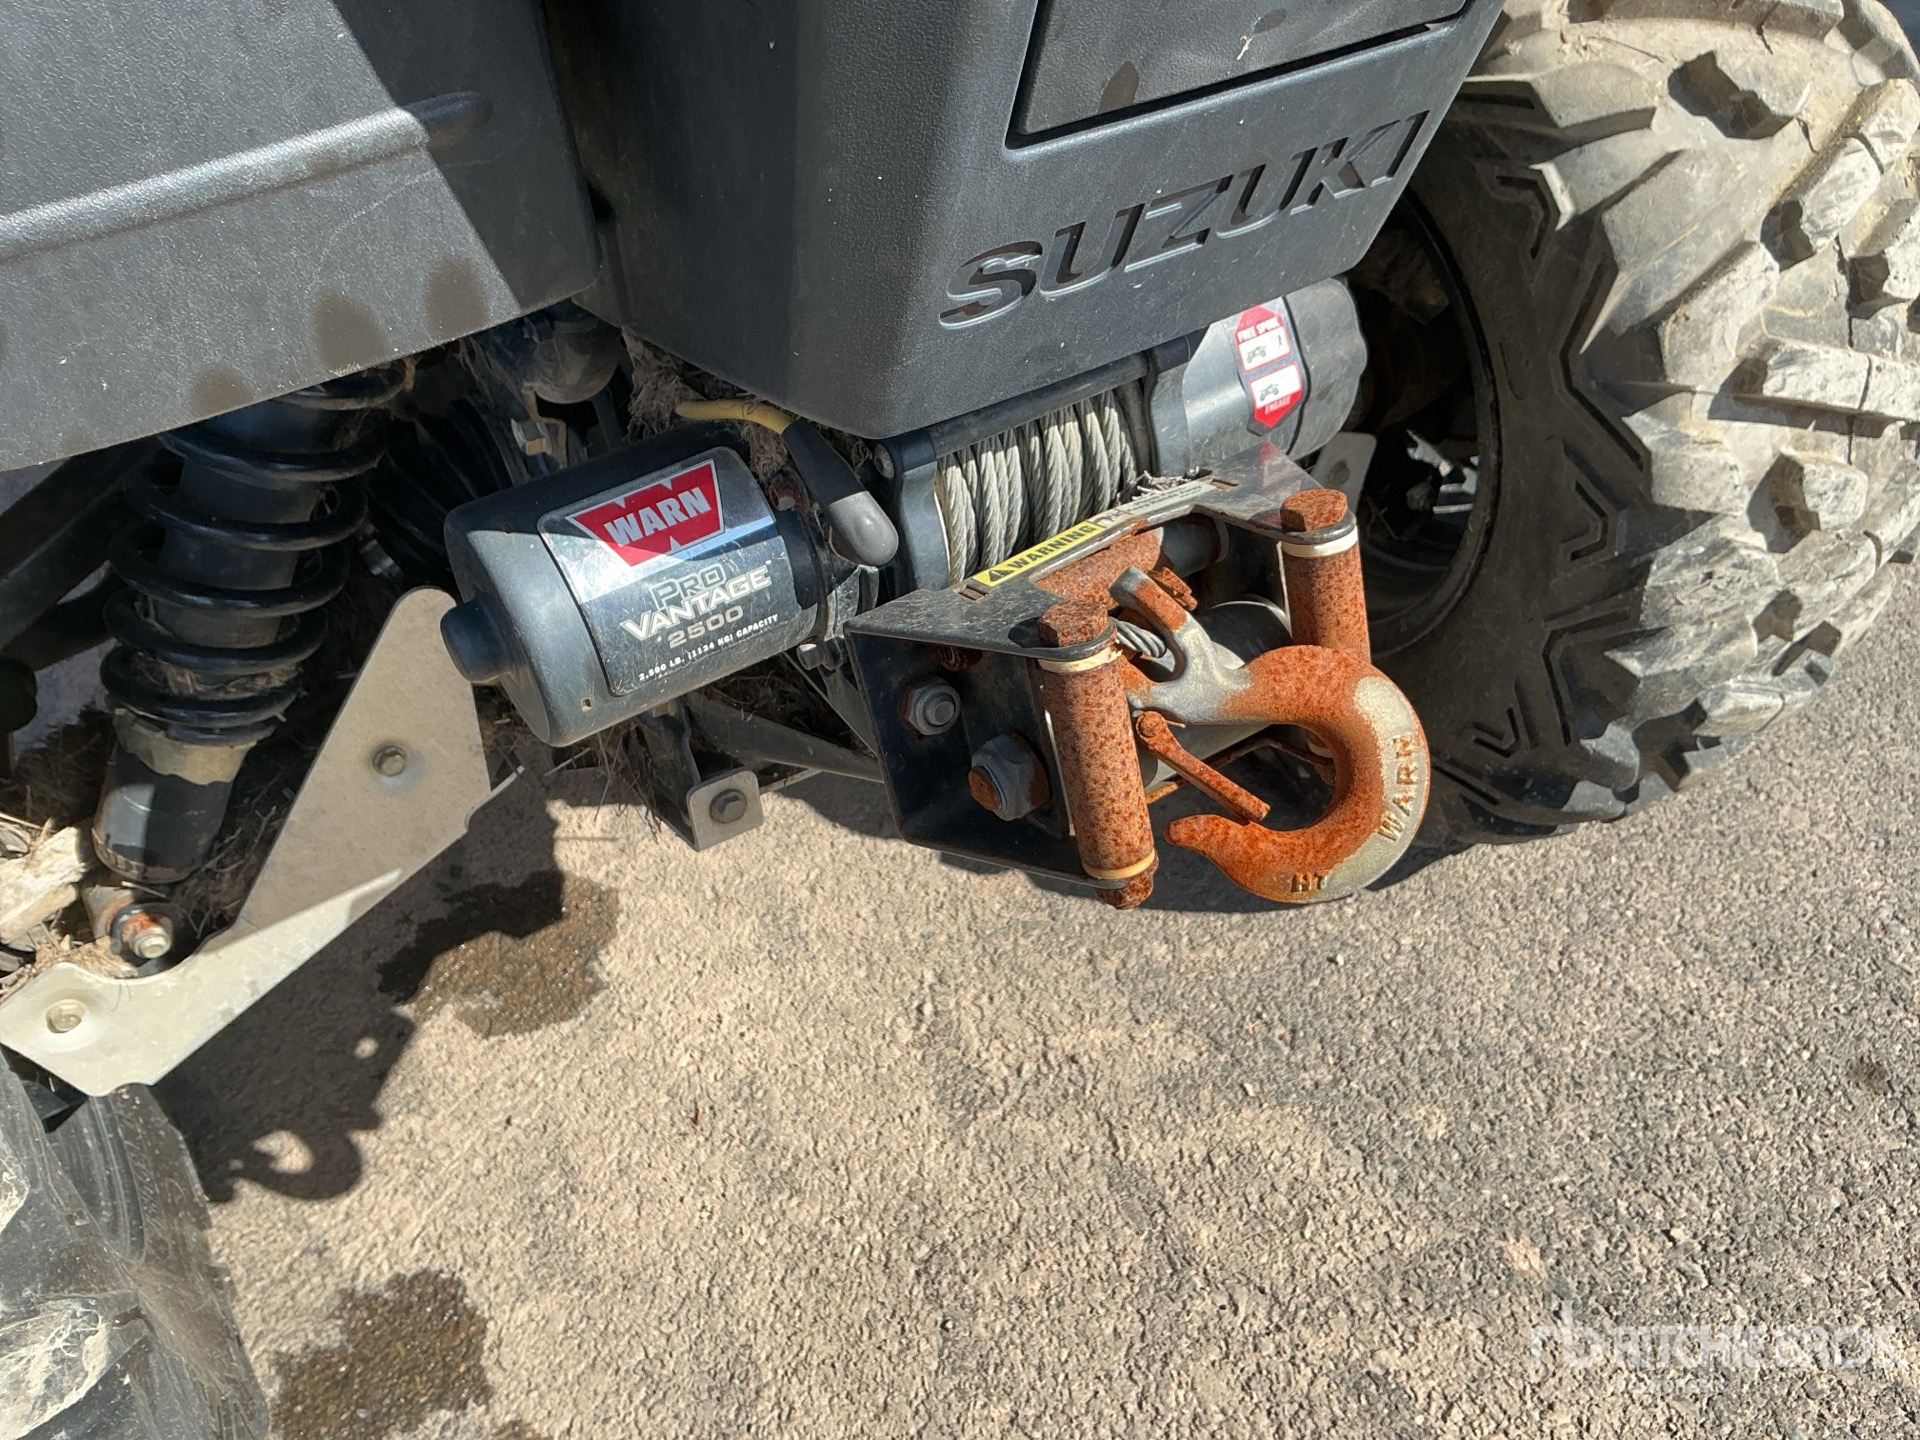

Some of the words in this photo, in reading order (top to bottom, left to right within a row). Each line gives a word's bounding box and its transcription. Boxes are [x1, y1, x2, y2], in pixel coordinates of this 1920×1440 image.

[939, 109, 1430, 330] SUZUKI
[1237, 325, 1258, 343] FREE
[1264, 395, 1291, 414] ENGAGE
[603, 486, 712, 546] WARN
[1009, 525, 1096, 568] WARNING
[619, 564, 770, 642] VANTAGE
[649, 562, 727, 611] PRO
[667, 605, 744, 649] 2500
[669, 655, 686, 669] LB.
[736, 613, 778, 637] CAPACITY
[1377, 731, 1420, 842] WARN
